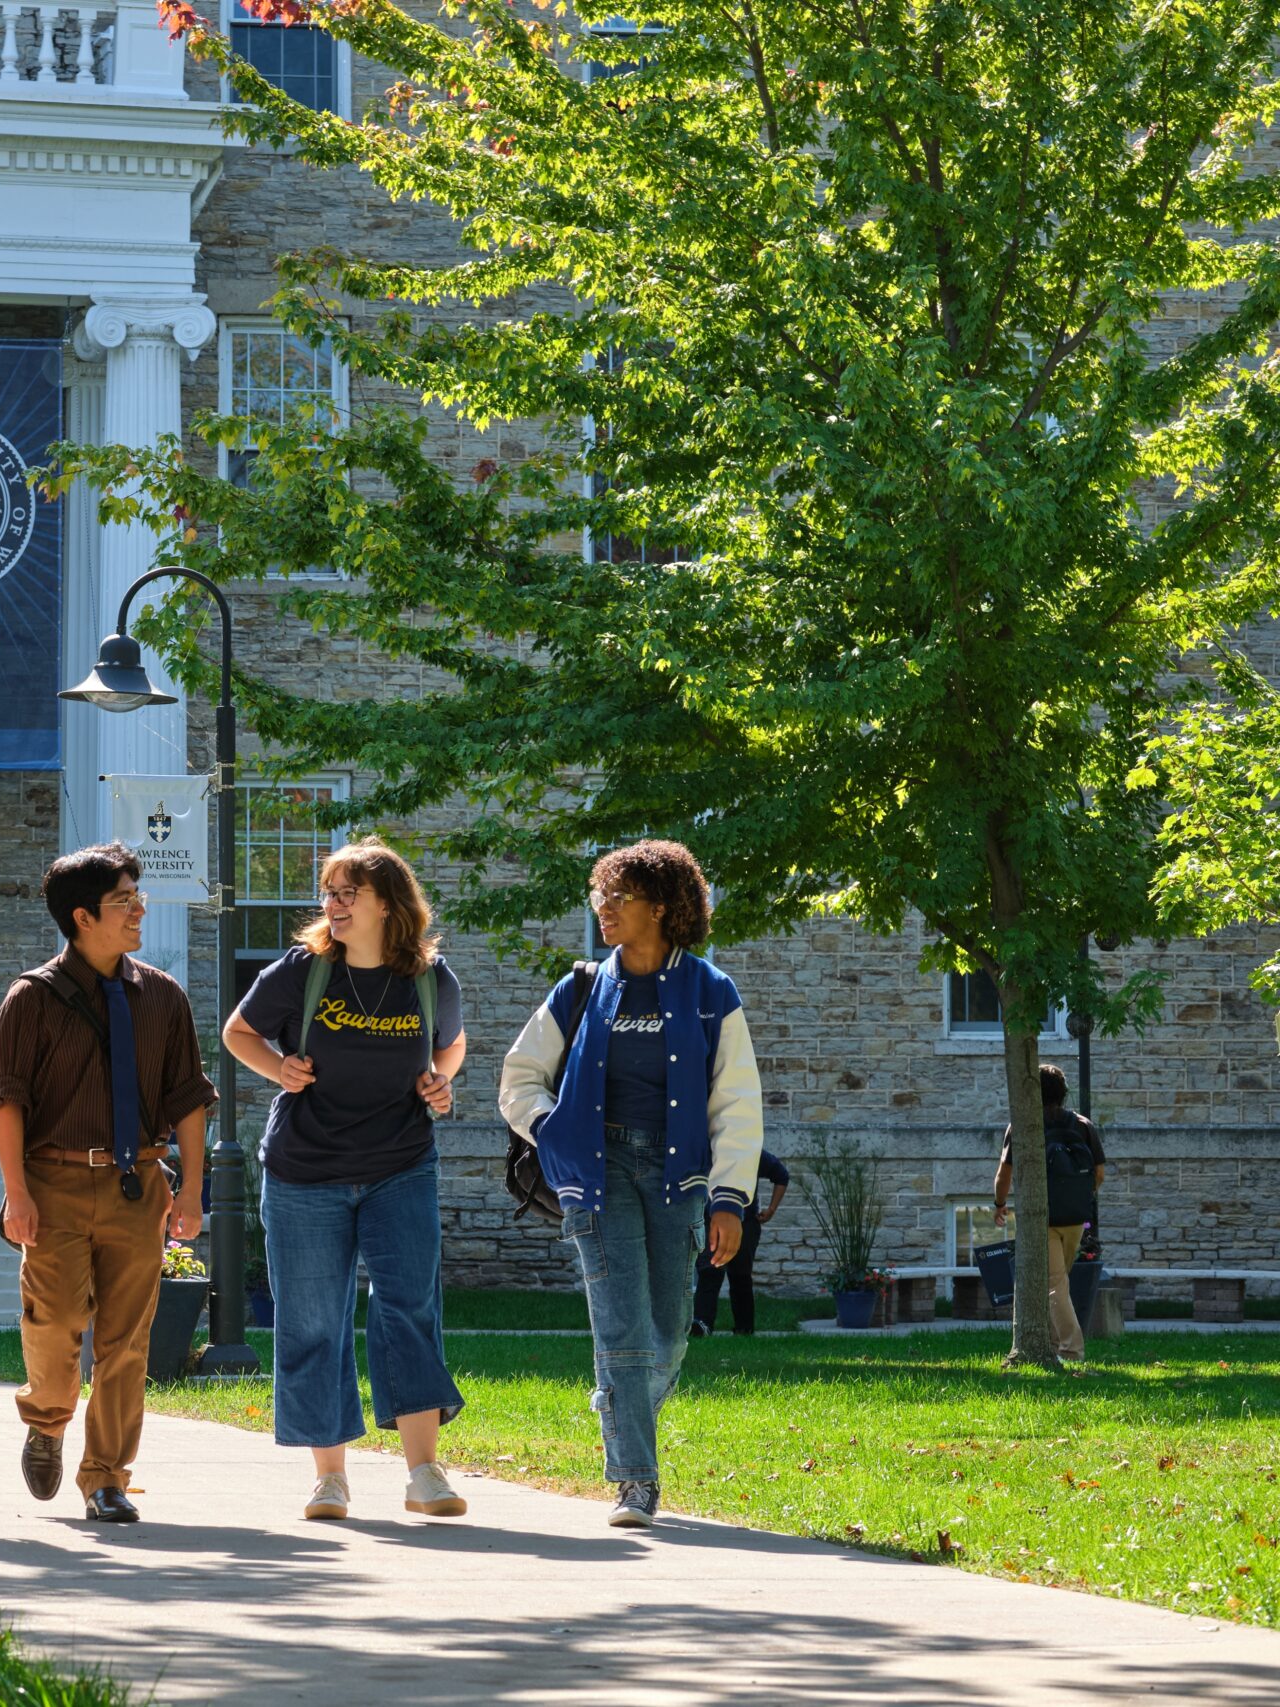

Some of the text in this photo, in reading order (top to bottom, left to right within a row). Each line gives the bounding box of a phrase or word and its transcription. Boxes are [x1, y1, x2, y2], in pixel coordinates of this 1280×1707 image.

[10, 507, 26, 537] OF
[130, 849, 191, 859] AWRENCE
[138, 861, 194, 870] IVERSITY
[314, 997, 421, 1031] Lawrence
